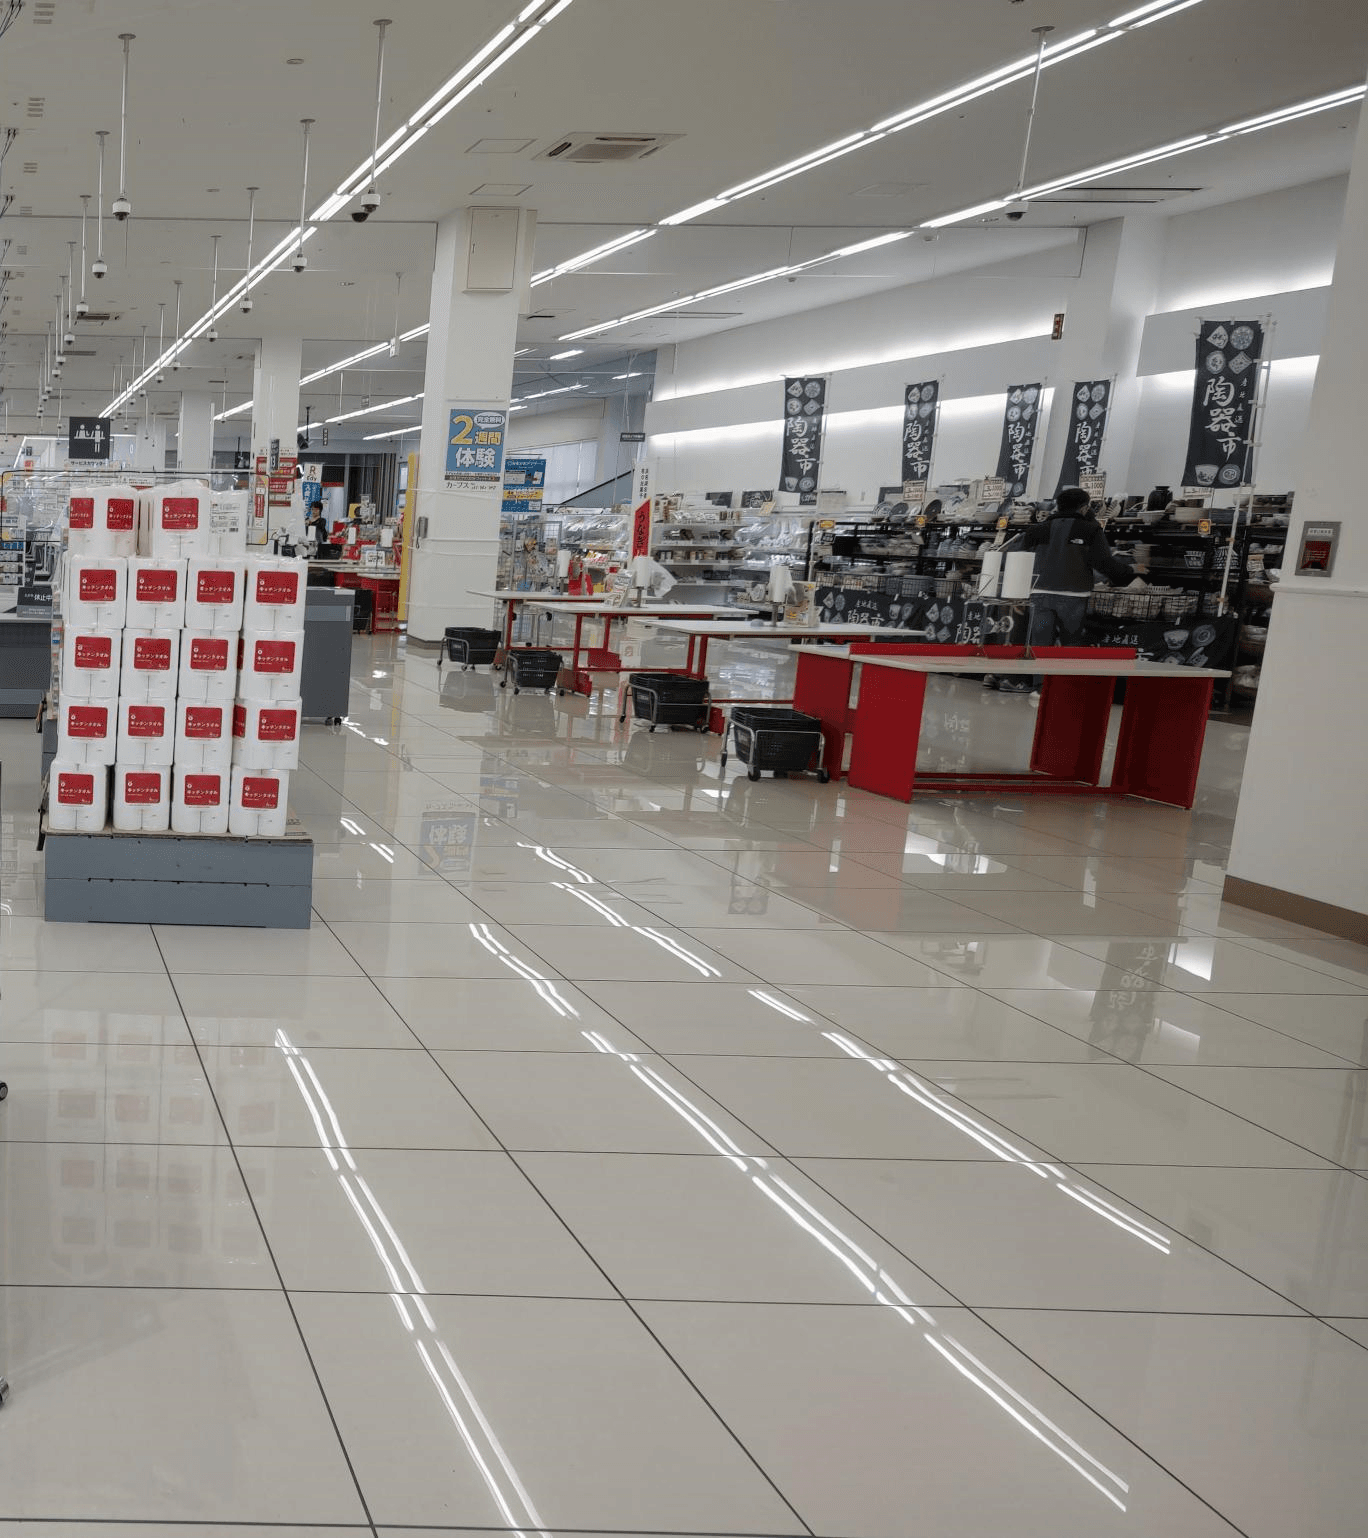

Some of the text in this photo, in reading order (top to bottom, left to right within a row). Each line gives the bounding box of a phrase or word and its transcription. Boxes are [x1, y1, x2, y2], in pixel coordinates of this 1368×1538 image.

[786, 415, 817, 476] 陶器市
[1203, 376, 1242, 462] 陶器市
[455, 447, 497, 469] 体験
[903, 422, 930, 479] 陶器市
[1007, 422, 1028, 480] 陶器市
